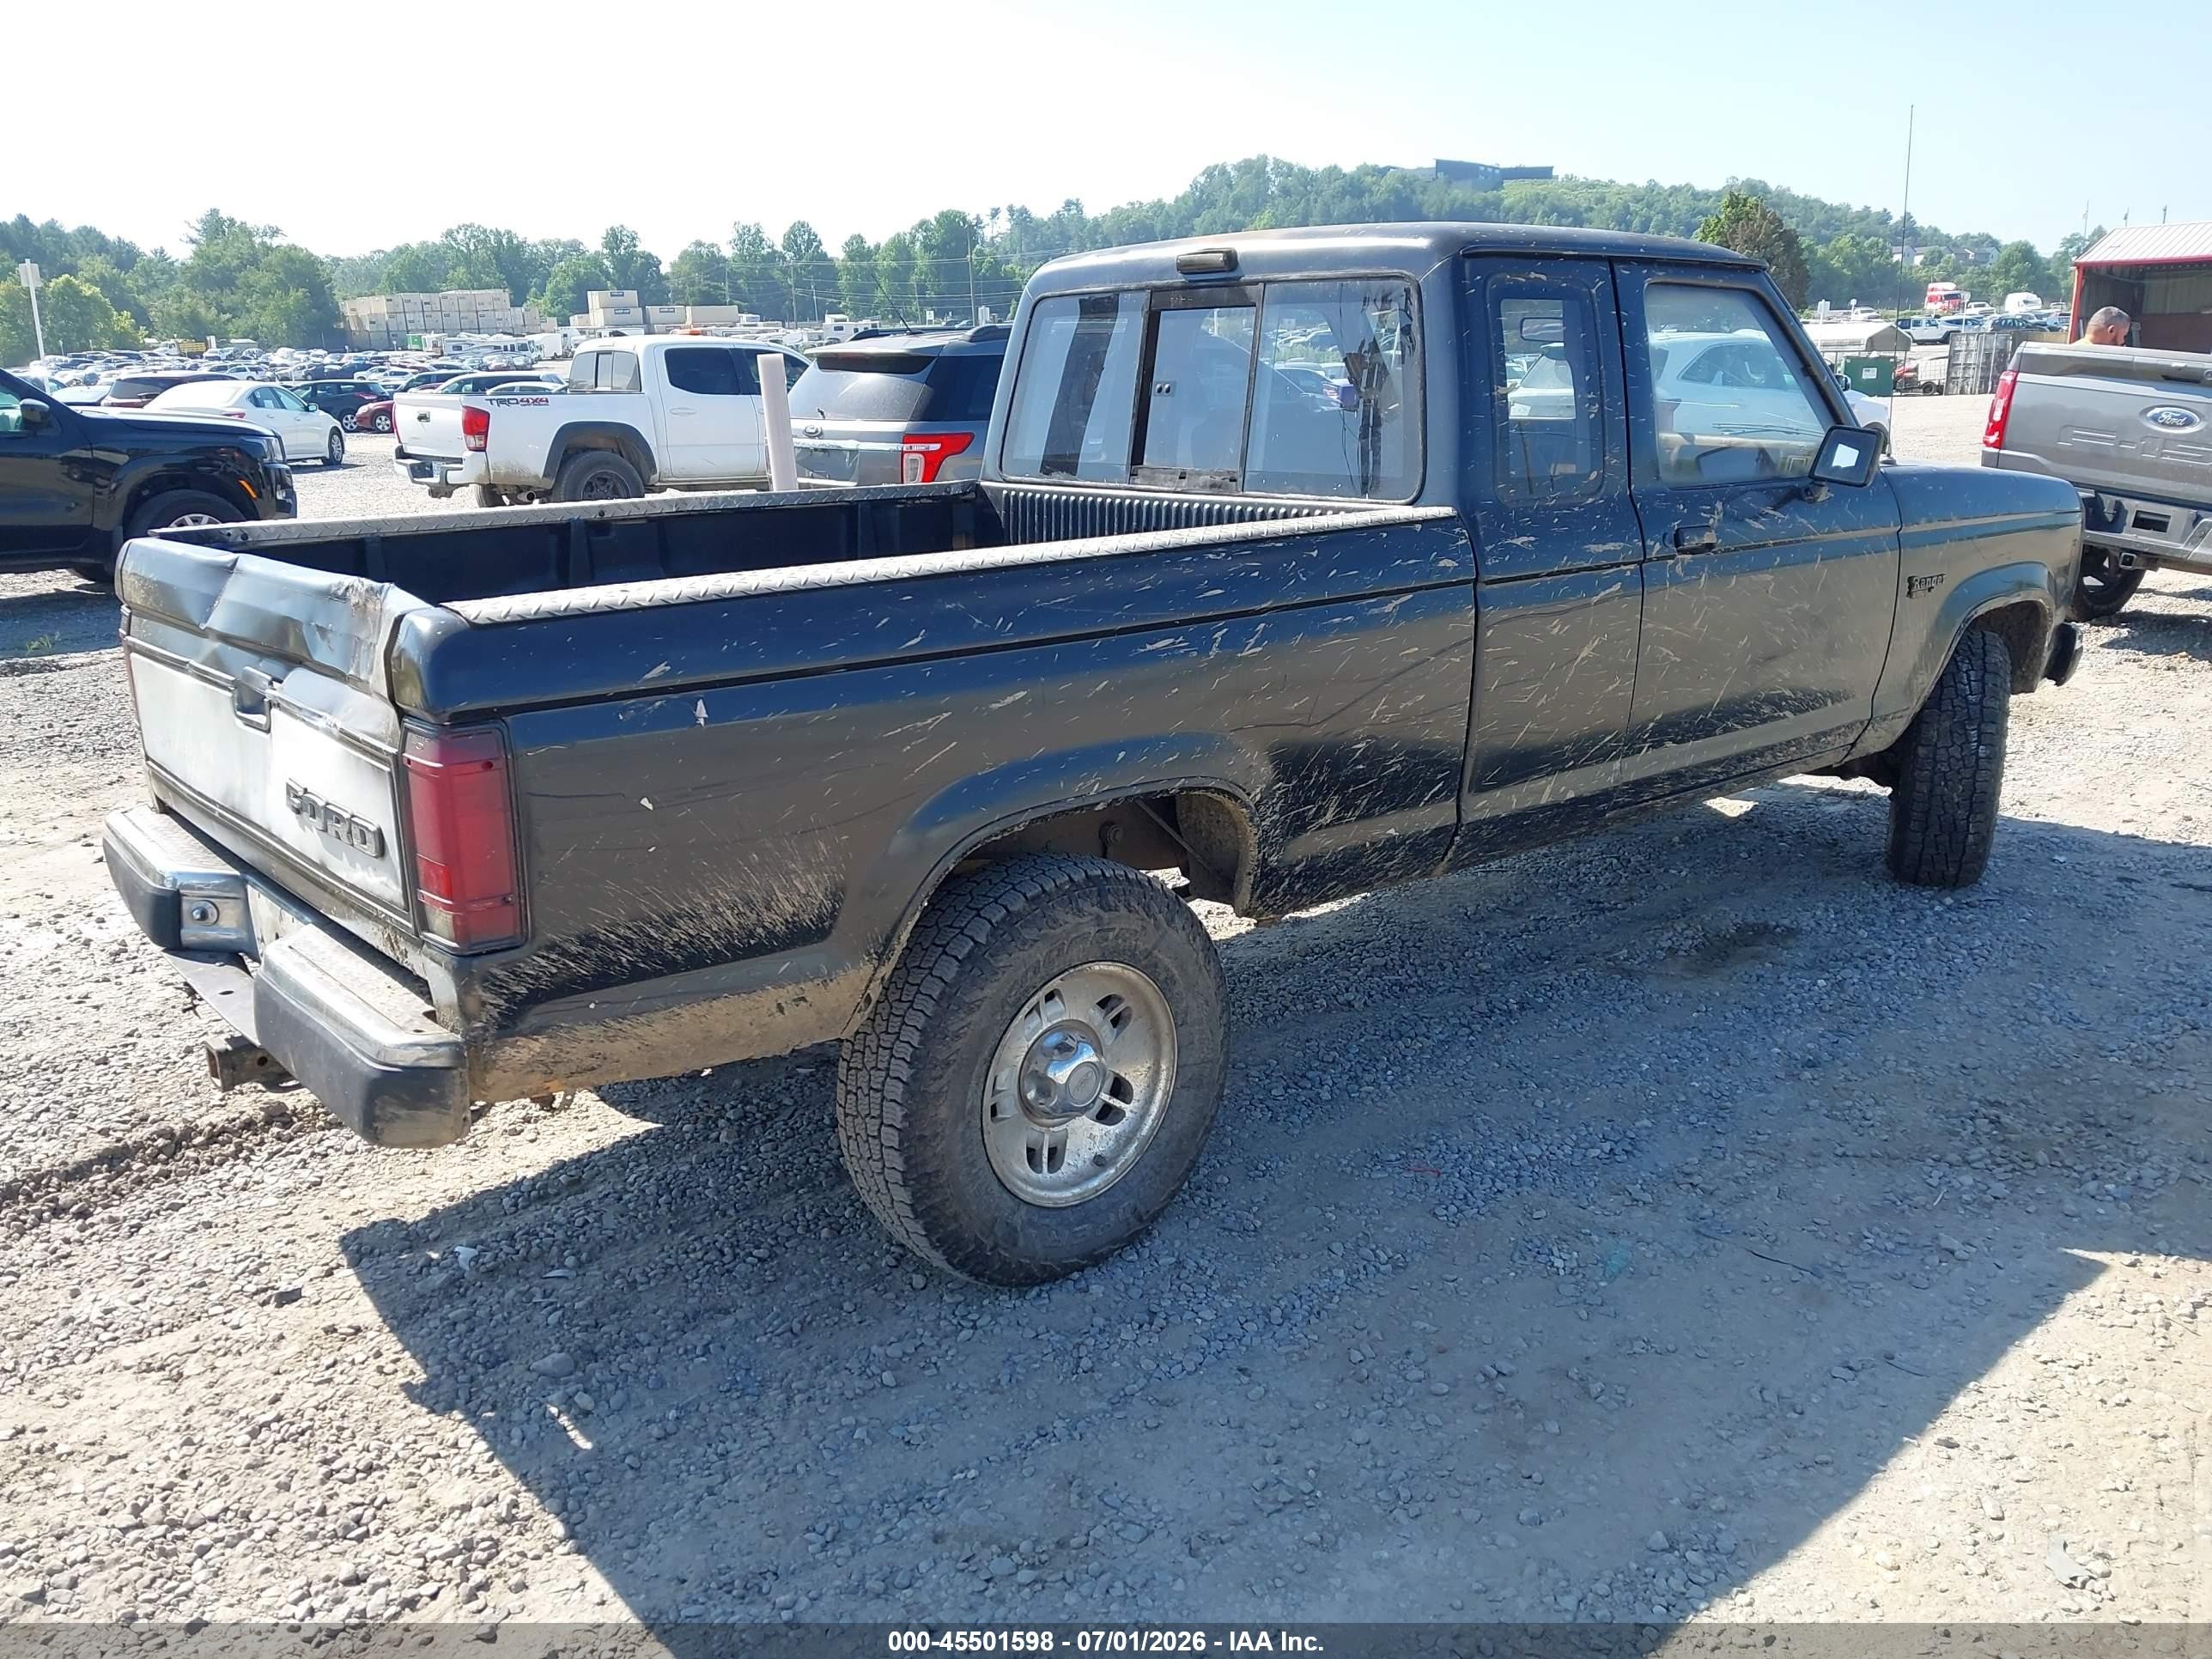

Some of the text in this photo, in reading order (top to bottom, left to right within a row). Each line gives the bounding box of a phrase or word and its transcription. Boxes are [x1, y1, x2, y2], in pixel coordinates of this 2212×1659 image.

[2157, 411, 2186, 426] Ford
[1910, 573, 1946, 592] Ranger
[286, 778, 385, 859] FORD
